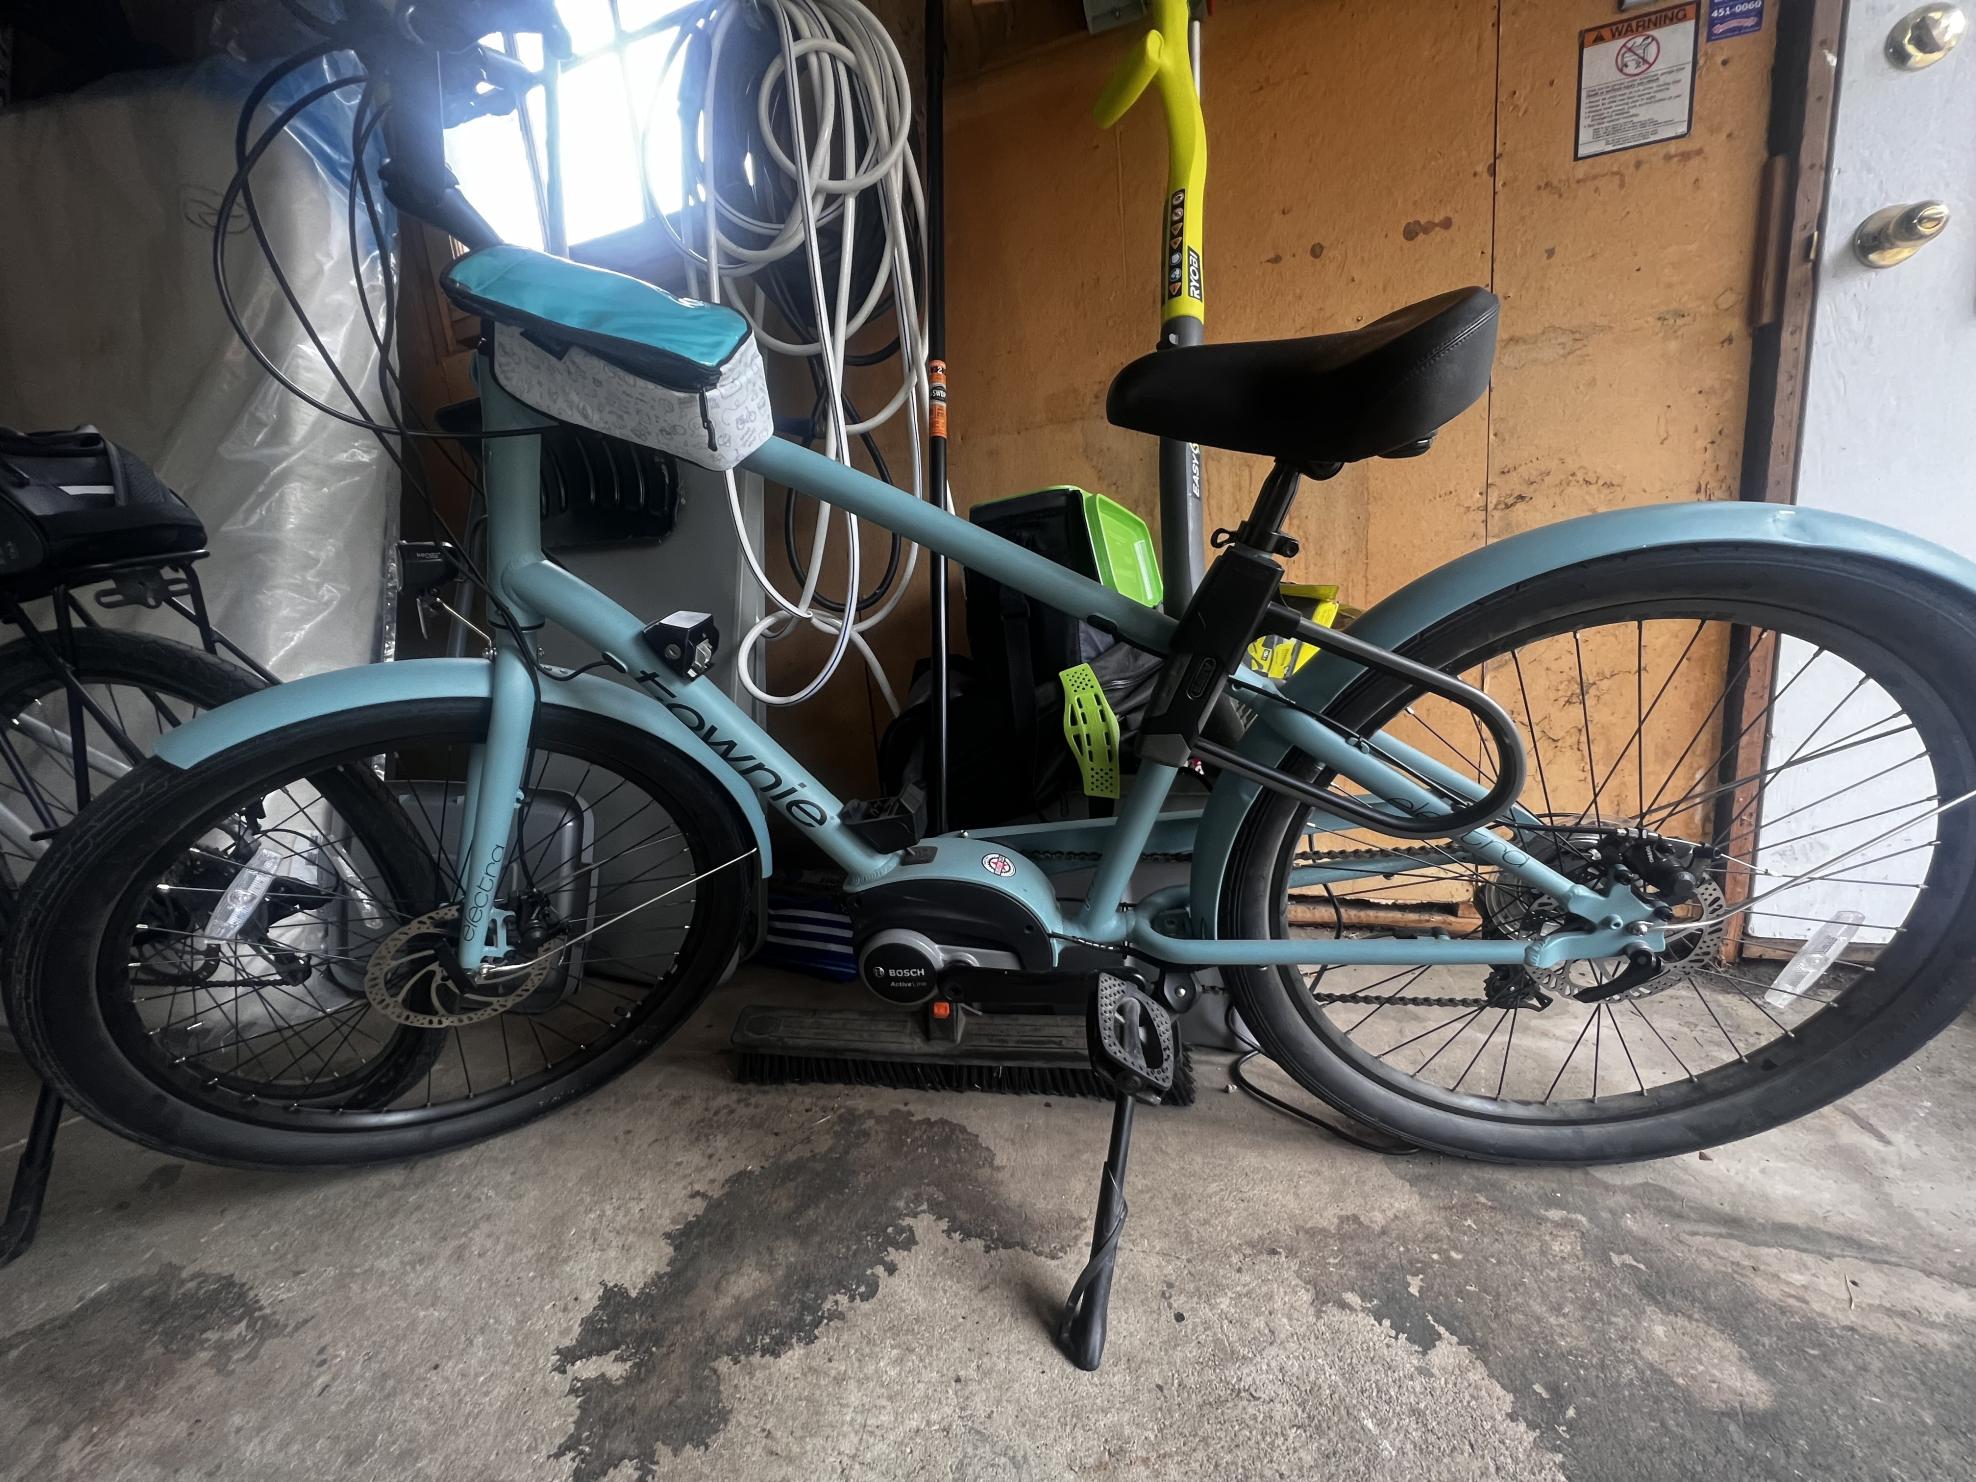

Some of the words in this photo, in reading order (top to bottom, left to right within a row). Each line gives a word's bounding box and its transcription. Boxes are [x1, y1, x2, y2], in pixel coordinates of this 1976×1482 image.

[1610, 9, 1688, 39] WARNING
[1189, 251, 1201, 299] RYOBI
[1191, 453, 1200, 498] EASY
[636, 670, 828, 828] townie
[1386, 797, 1531, 868] eltra
[463, 844, 505, 942] electra
[888, 968, 925, 977] BOSCH
